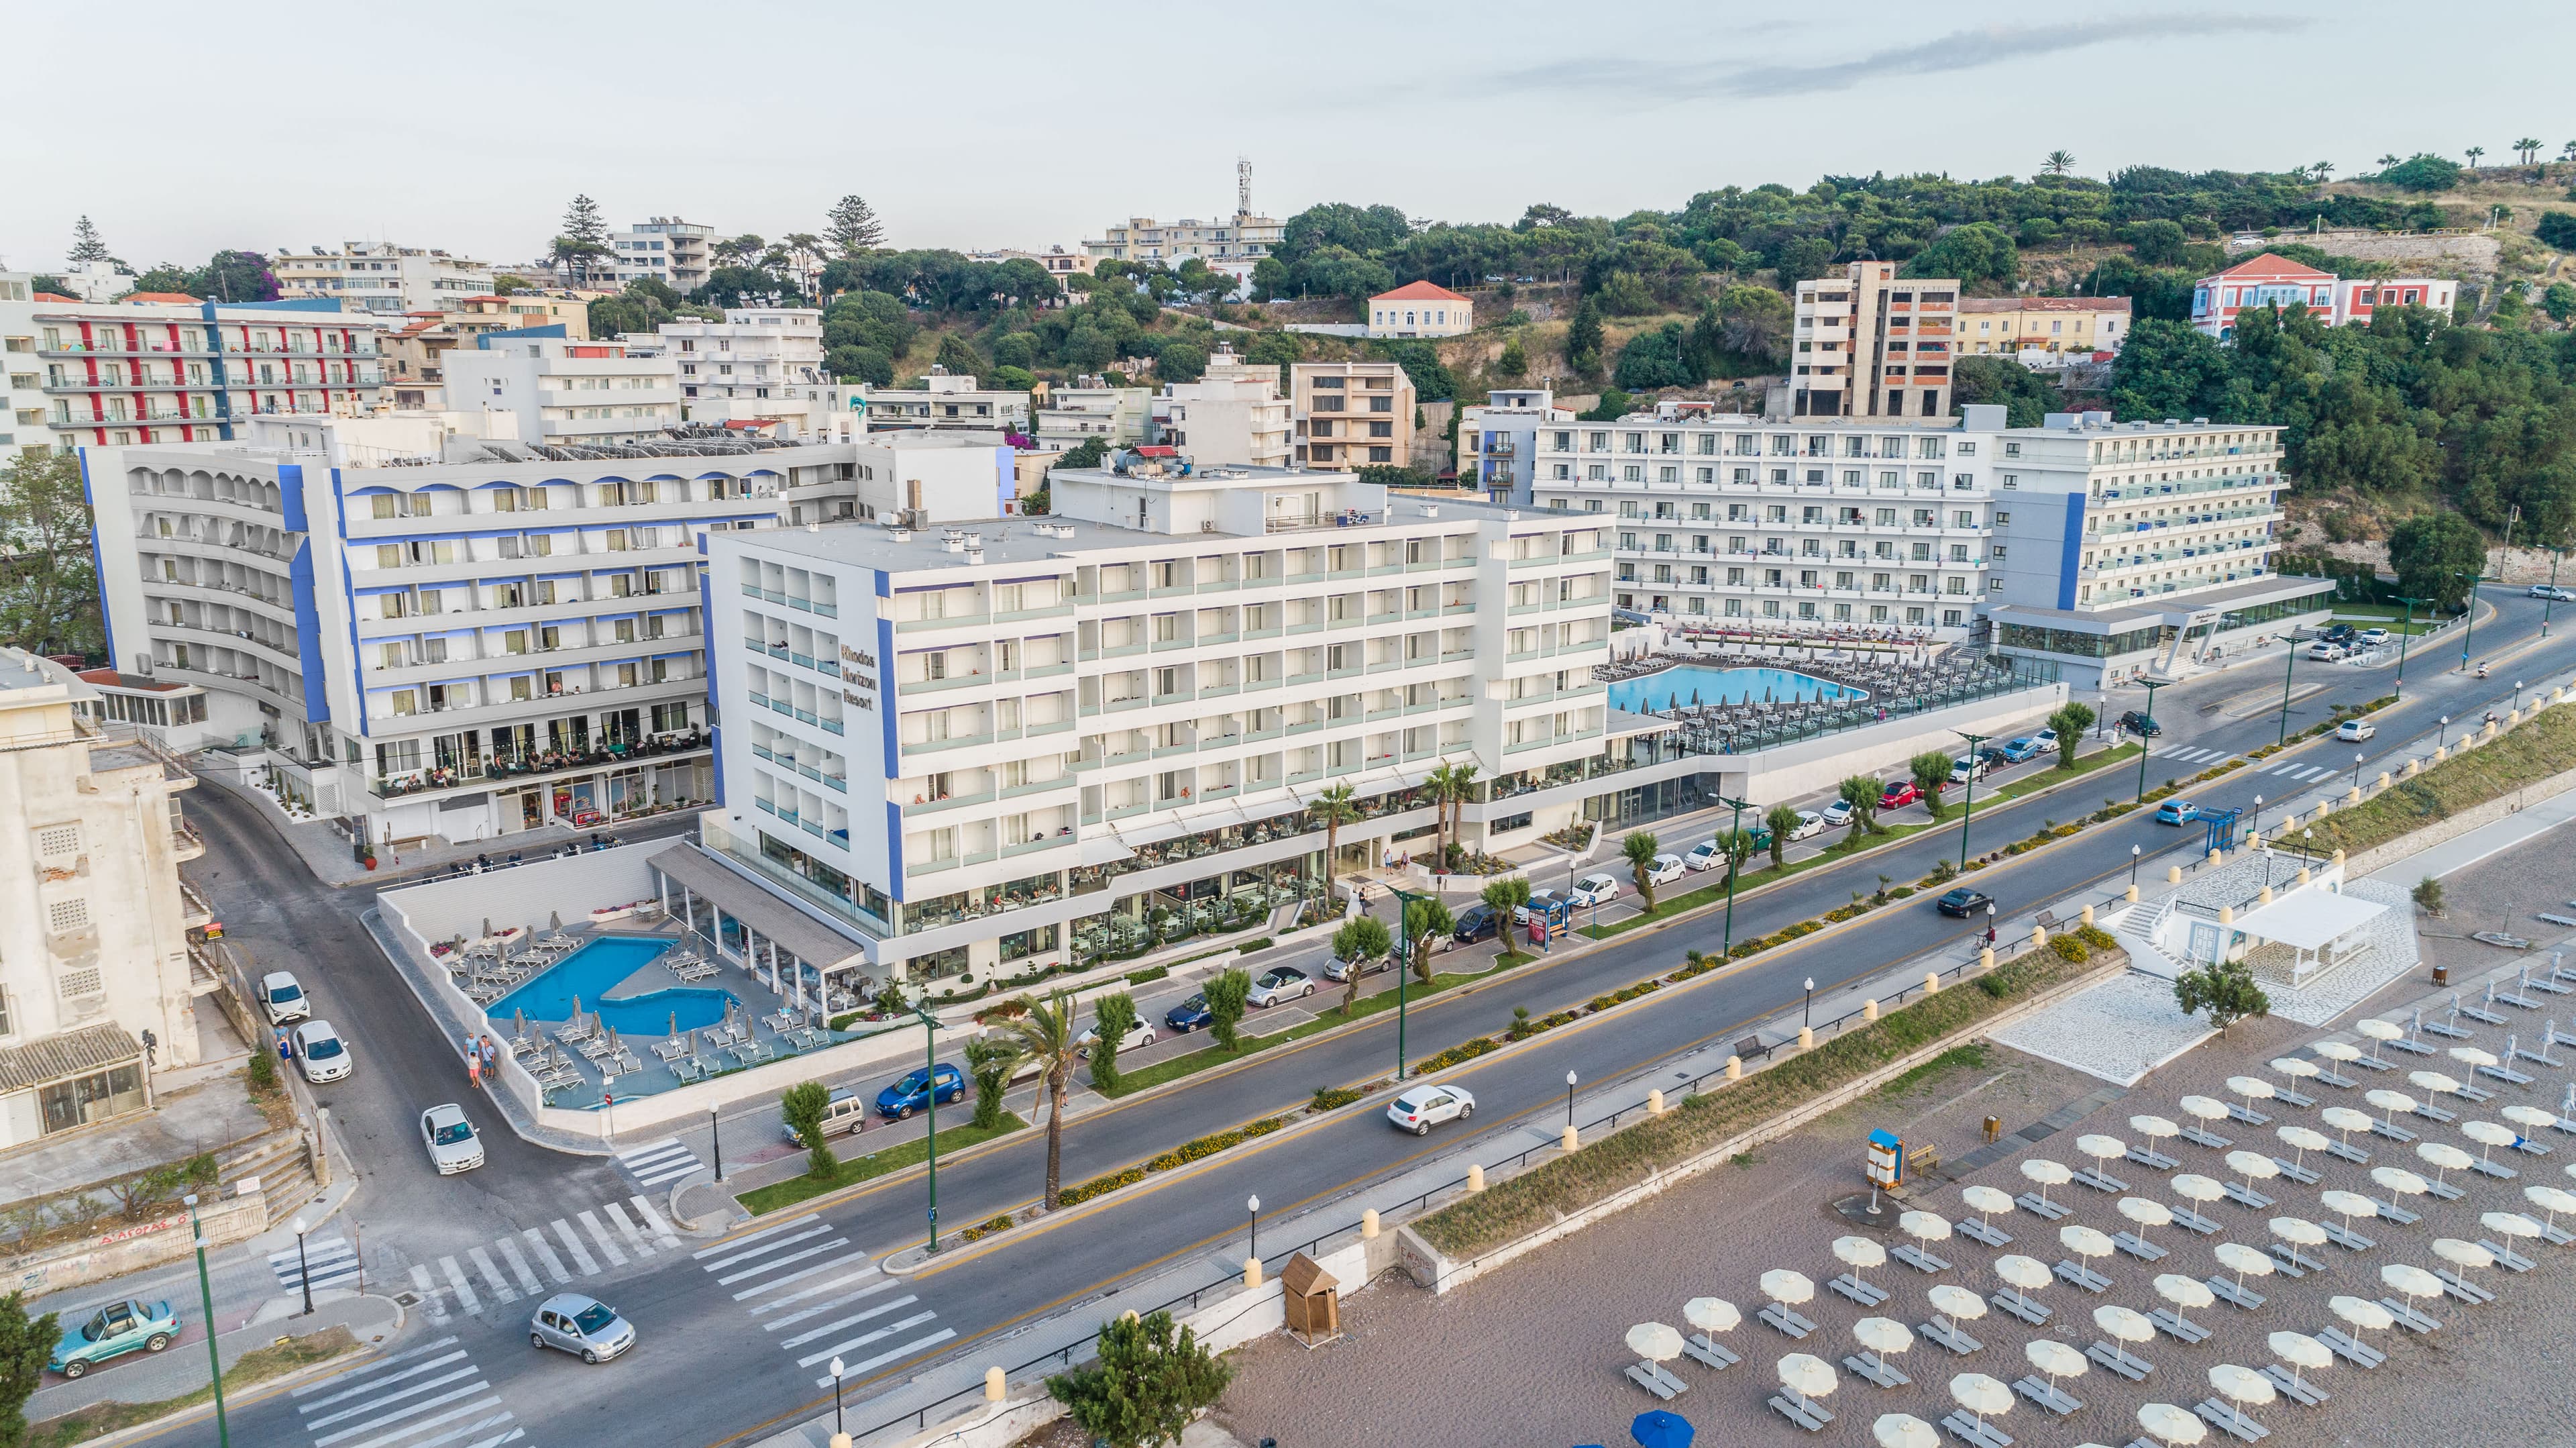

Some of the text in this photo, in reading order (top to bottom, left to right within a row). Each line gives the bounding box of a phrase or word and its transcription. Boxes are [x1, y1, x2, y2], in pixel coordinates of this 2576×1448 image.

[841, 644, 875, 668] Rhodos
[842, 666, 877, 690] Horizon
[843, 688, 873, 711] Resort
